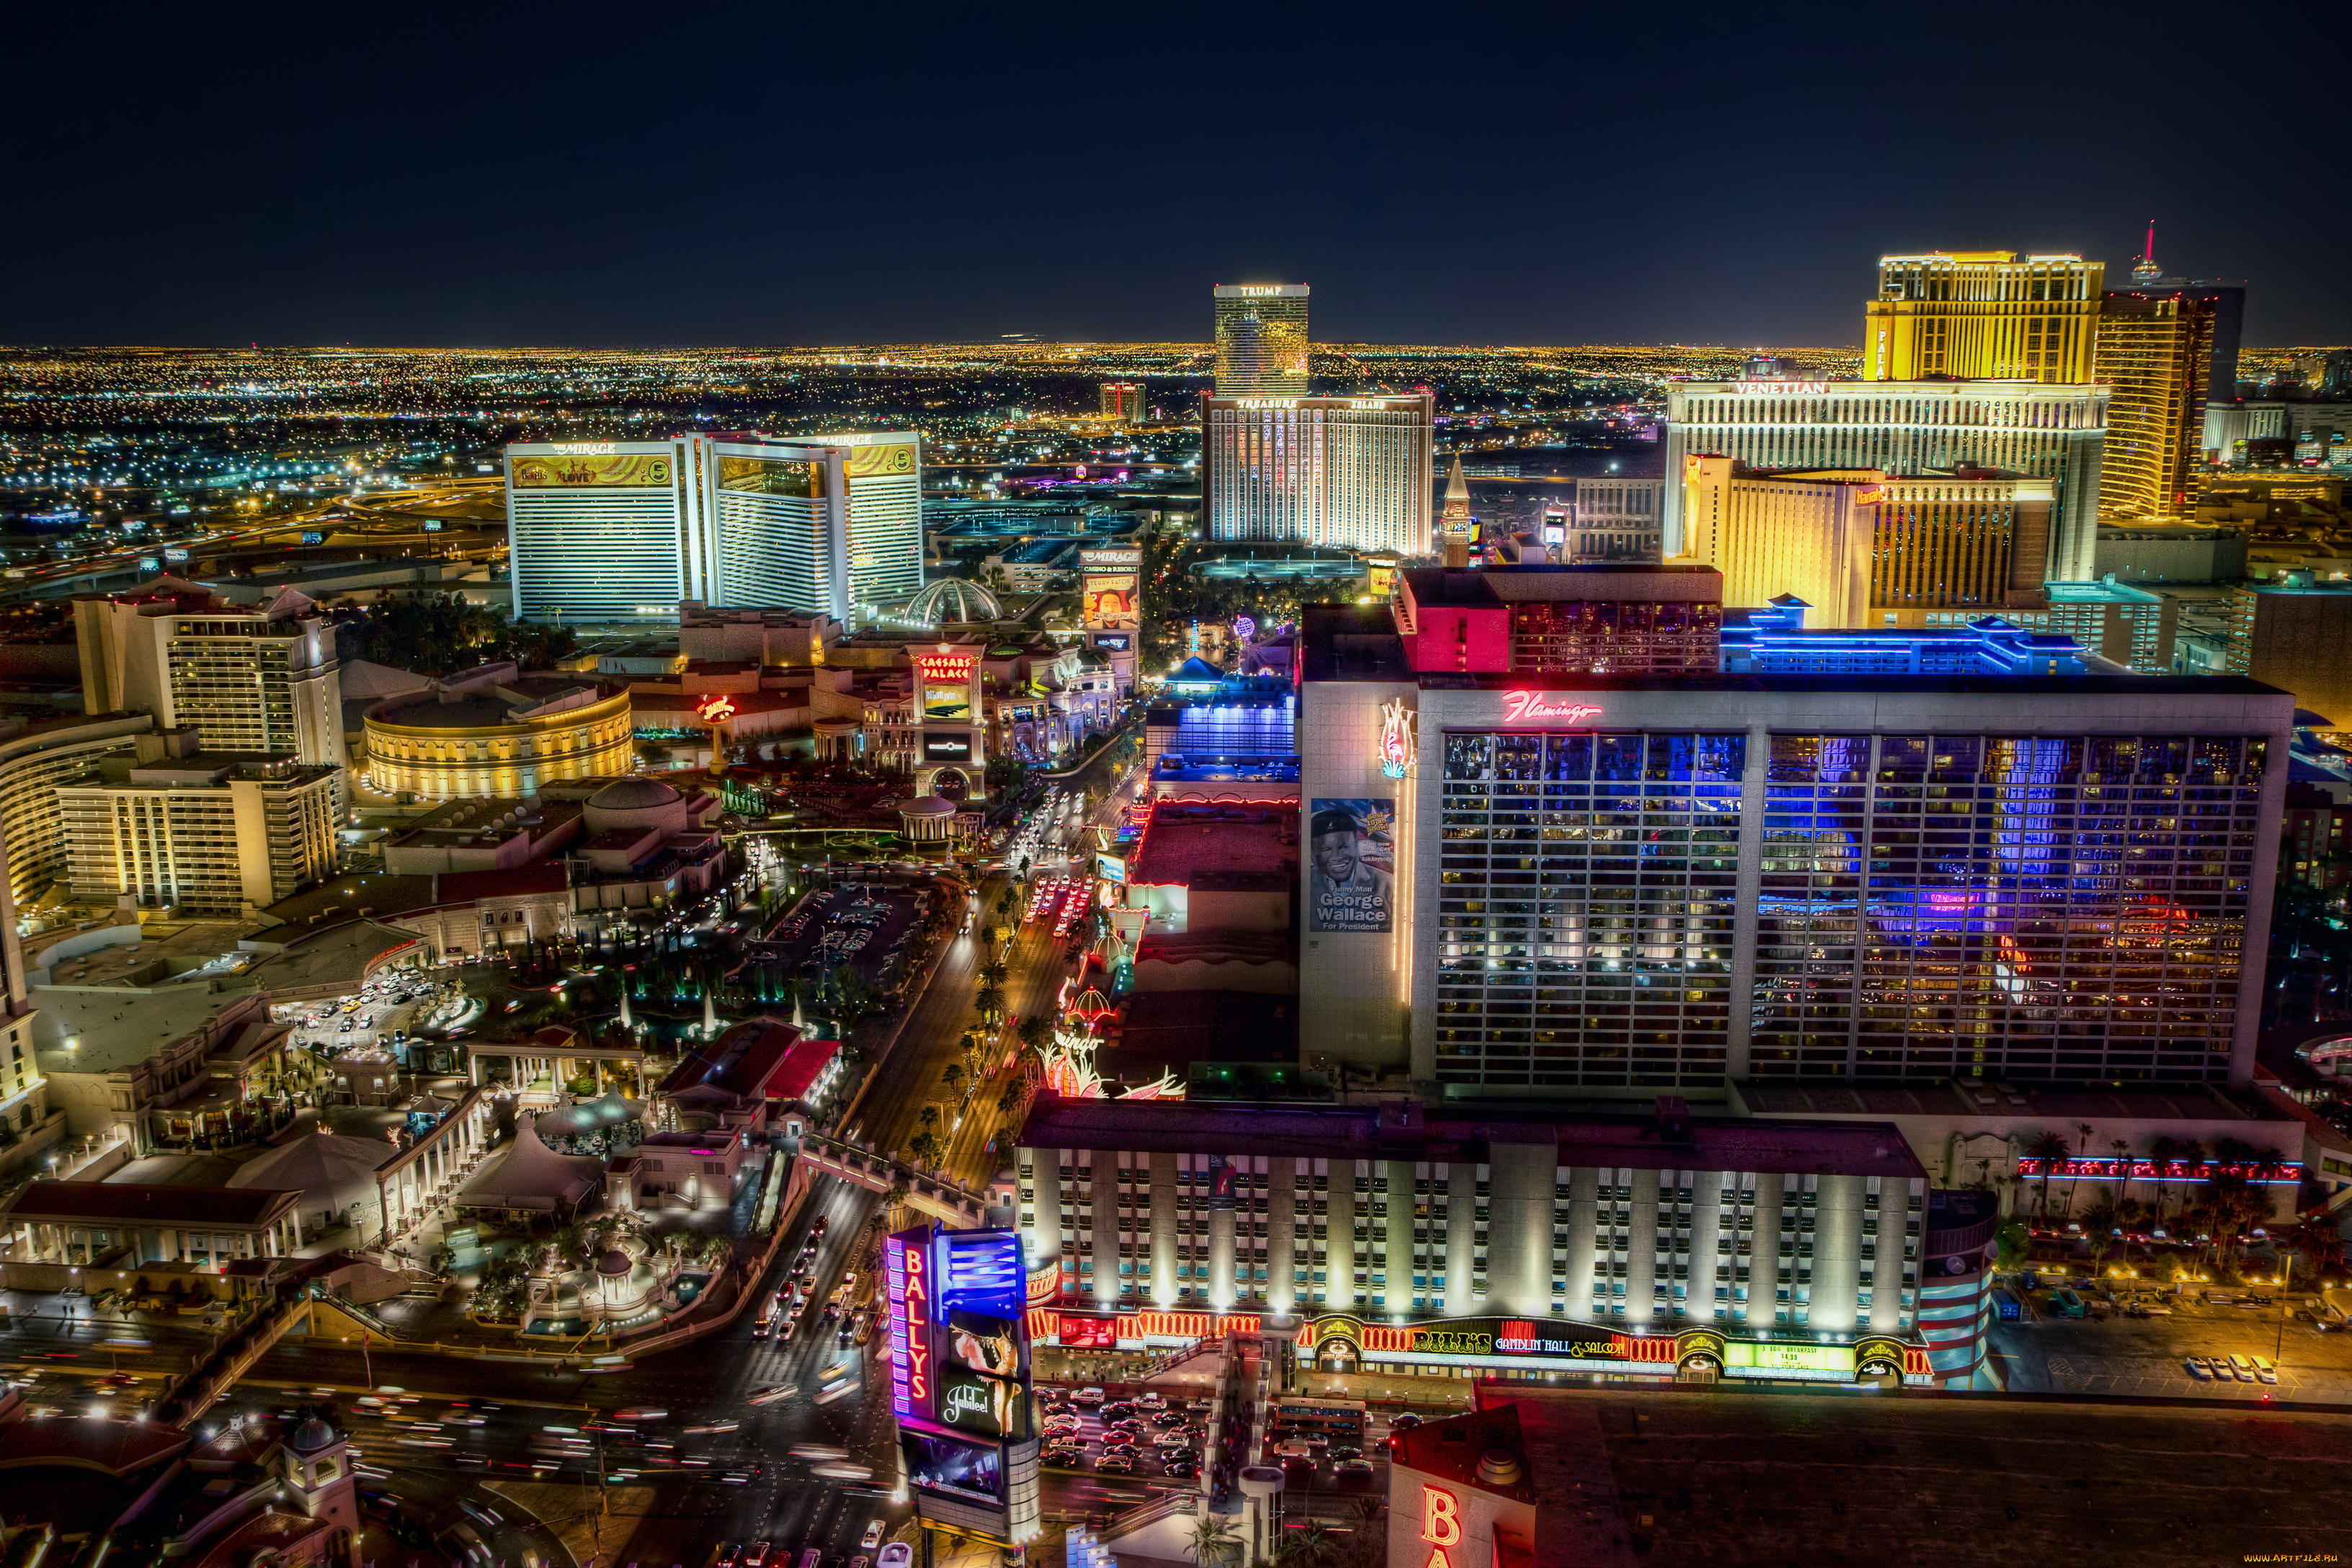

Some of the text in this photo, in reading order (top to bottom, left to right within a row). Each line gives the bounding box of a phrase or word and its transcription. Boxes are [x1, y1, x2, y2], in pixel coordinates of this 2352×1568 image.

[1241, 286, 1282, 296] TRUMP
[1876, 329, 1886, 380] PALA
[1735, 382, 1827, 395] VENETIAN
[1237, 398, 1386, 410] TREASURE ISLAND
[827, 435, 872, 447] MIRAGE
[558, 443, 616, 455] MIRAGE
[563, 473, 590, 483] LOVE
[1086, 551, 1139, 564] MIRAGE
[919, 657, 971, 667] CAESARS
[923, 668, 969, 678] PALACE
[926, 689, 944, 701] elton
[944, 690, 956, 703] john
[1502, 689, 1603, 725] Flamingo
[1367, 811, 1384, 820] Best
[1366, 818, 1387, 827] 10pm
[1366, 823, 1389, 832] Show!
[1319, 892, 1384, 909] George
[1316, 907, 1387, 922] Wallace
[904, 1249, 928, 1399] BALLYS
[1412, 1330, 1492, 1355] BILL'S
[1495, 1337, 1626, 1358] GAMBLIN' HALL & SALOON
[943, 1384, 989, 1423] Jubilee!
